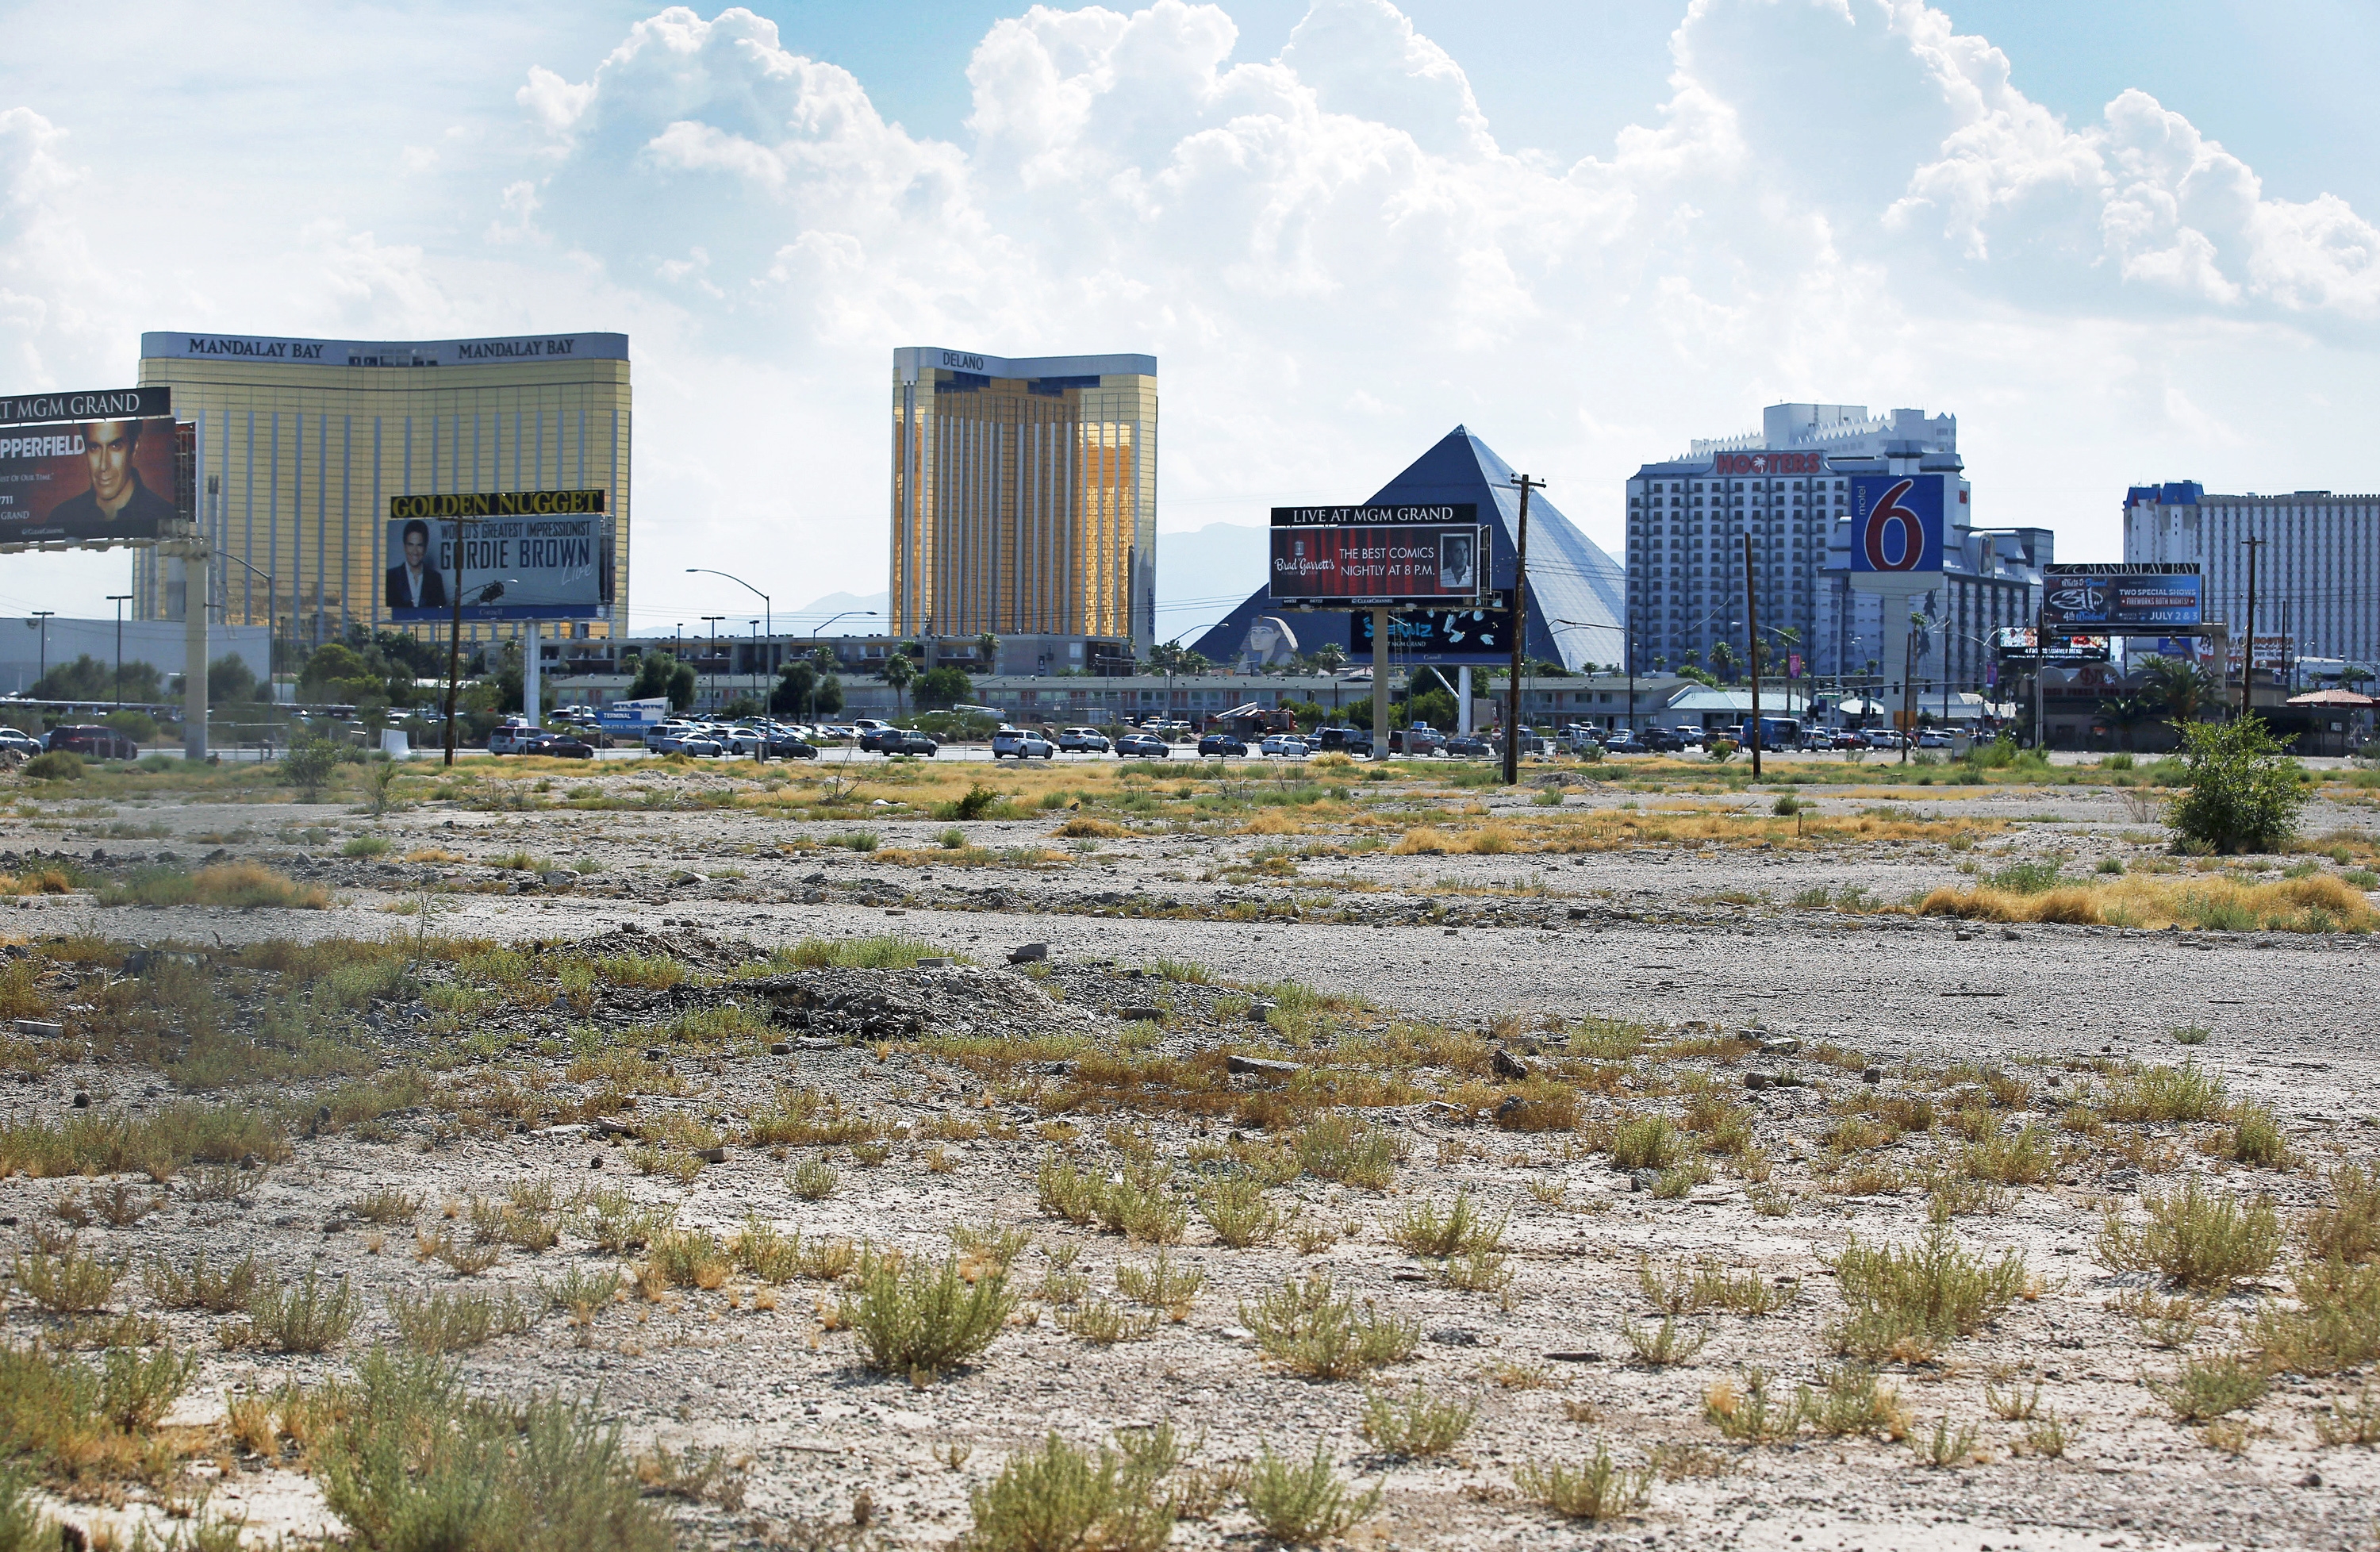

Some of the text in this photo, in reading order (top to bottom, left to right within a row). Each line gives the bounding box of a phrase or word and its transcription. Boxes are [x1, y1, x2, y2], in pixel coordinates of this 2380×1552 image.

[188, 339, 324, 358] MANDALAY BAY
[459, 339, 575, 359] MANDALAY BAY
[942, 352, 984, 371] DELANO
[17, 398, 65, 418] MGM
[71, 394, 140, 415] GRAND
[1716, 452, 1821, 474] HOOTERS
[392, 490, 599, 517] GOLDEN NUGGET
[1, 510, 30, 521] GRAND
[1293, 507, 1453, 523] LIVE AT MGM GRAND
[482, 522, 524, 539] GREATEST
[527, 521, 591, 537] IMPRESSIONIST
[1864, 478, 1925, 571] 6
[520, 539, 590, 568] BROWN
[1339, 547, 1434, 559] THE BEST COMICS
[562, 559, 593, 586] Live
[1274, 558, 1335, 575] Brad Garrett's
[1341, 565, 1435, 576] NIGHTLY AT 8 P.M.
[2086, 563, 2165, 574] MANDALAY
[2171, 563, 2198, 574] BAY
[2126, 597, 2155, 605] FIREWORKS
[2155, 597, 2168, 605] BOTH
[2149, 612, 2198, 620] JULY 2 & 3
